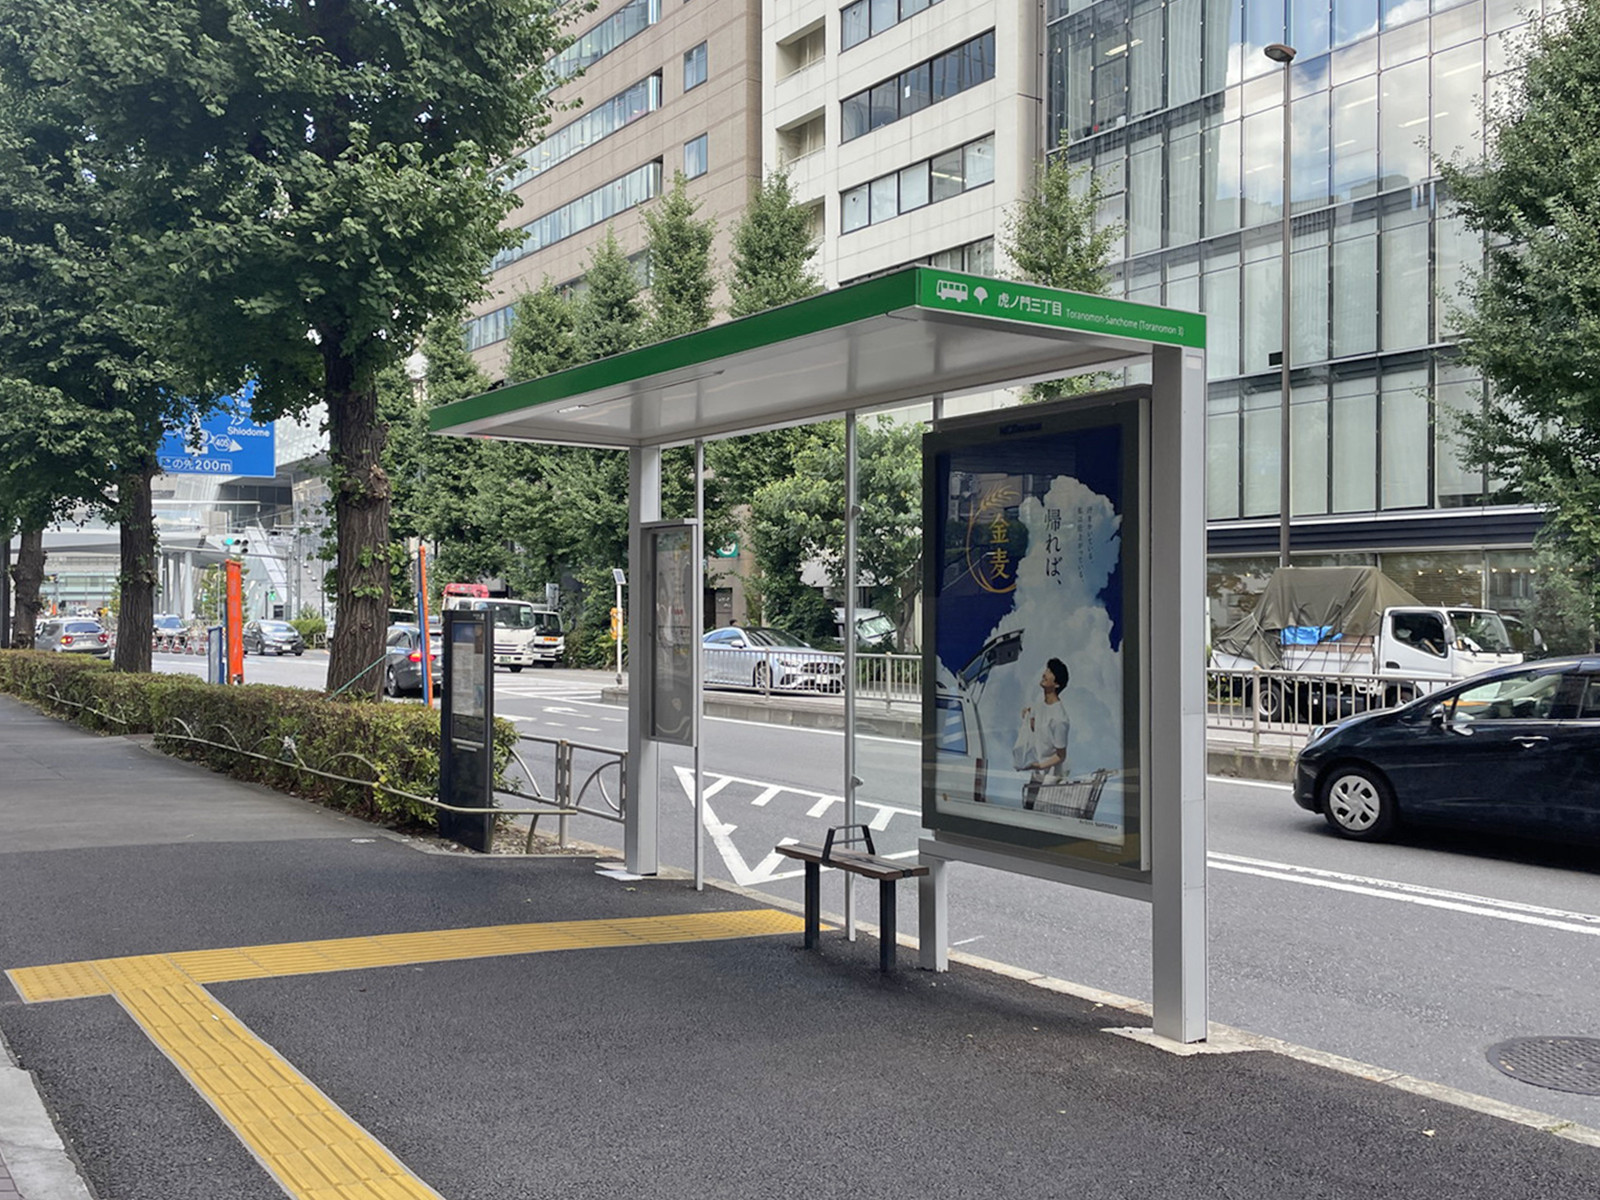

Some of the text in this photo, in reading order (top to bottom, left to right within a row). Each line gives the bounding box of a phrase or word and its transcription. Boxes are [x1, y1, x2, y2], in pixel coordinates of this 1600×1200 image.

[998, 292, 1062, 317] 虎ノ門三丁目
[227, 426, 271, 438] Shiodome
[989, 512, 1010, 580] 金麦
[1044, 508, 1062, 585] 帰れば、
